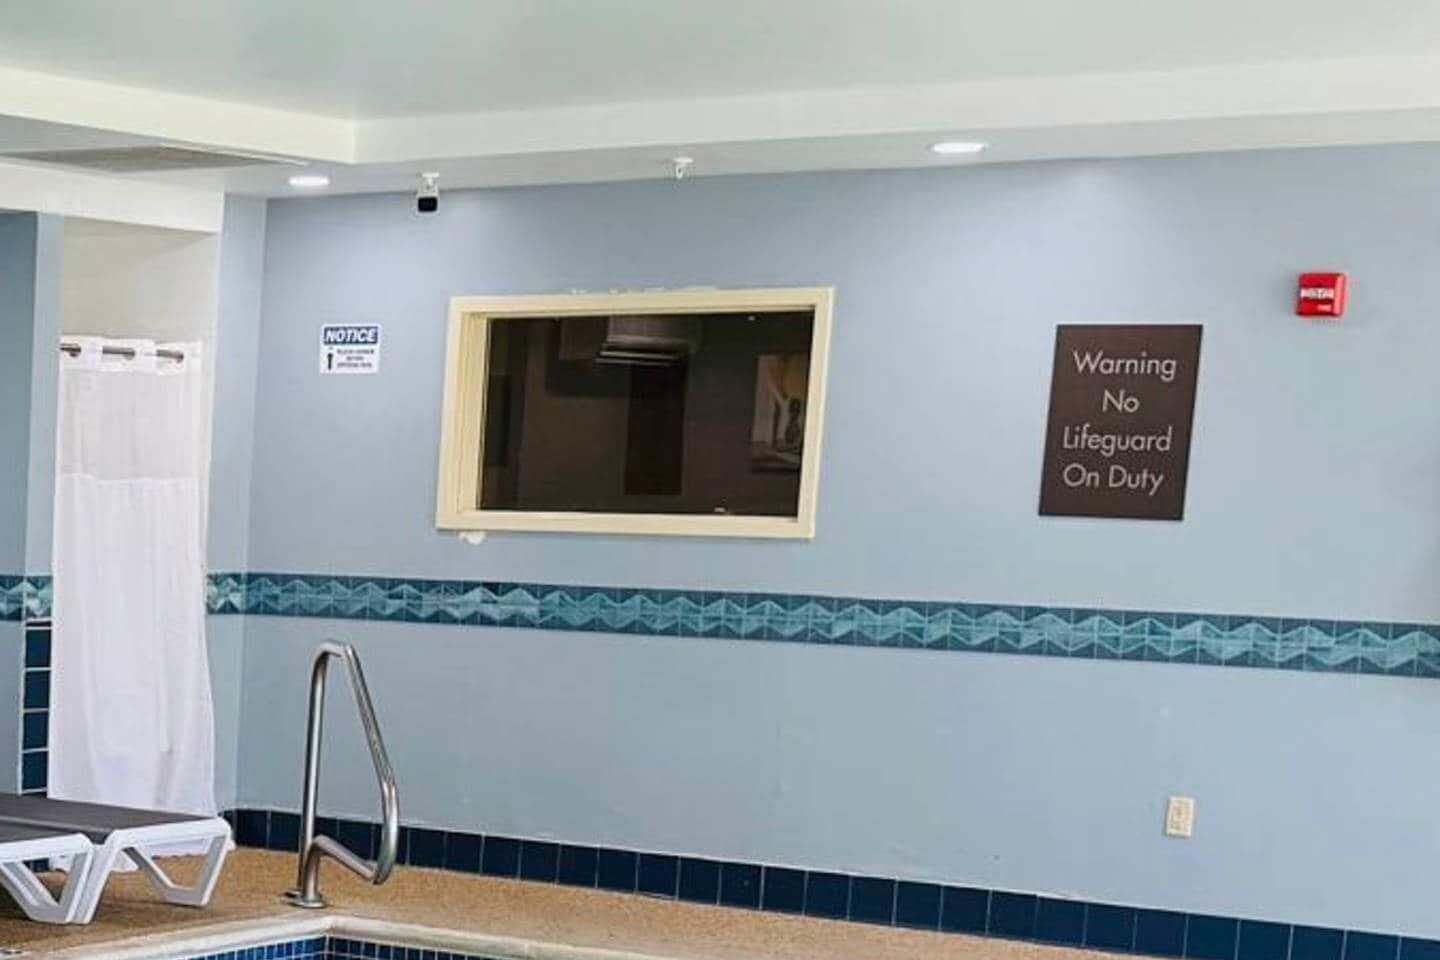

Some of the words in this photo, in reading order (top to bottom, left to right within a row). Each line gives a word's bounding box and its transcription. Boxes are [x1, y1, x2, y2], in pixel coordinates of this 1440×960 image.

[326, 328, 377, 342] NOTICE
[1072, 349, 1177, 382] Warning
[1101, 389, 1141, 413] No
[1062, 423, 1174, 458] Lifeguard
[1062, 463, 1101, 488] On
[1108, 464, 1165, 497] Duty
